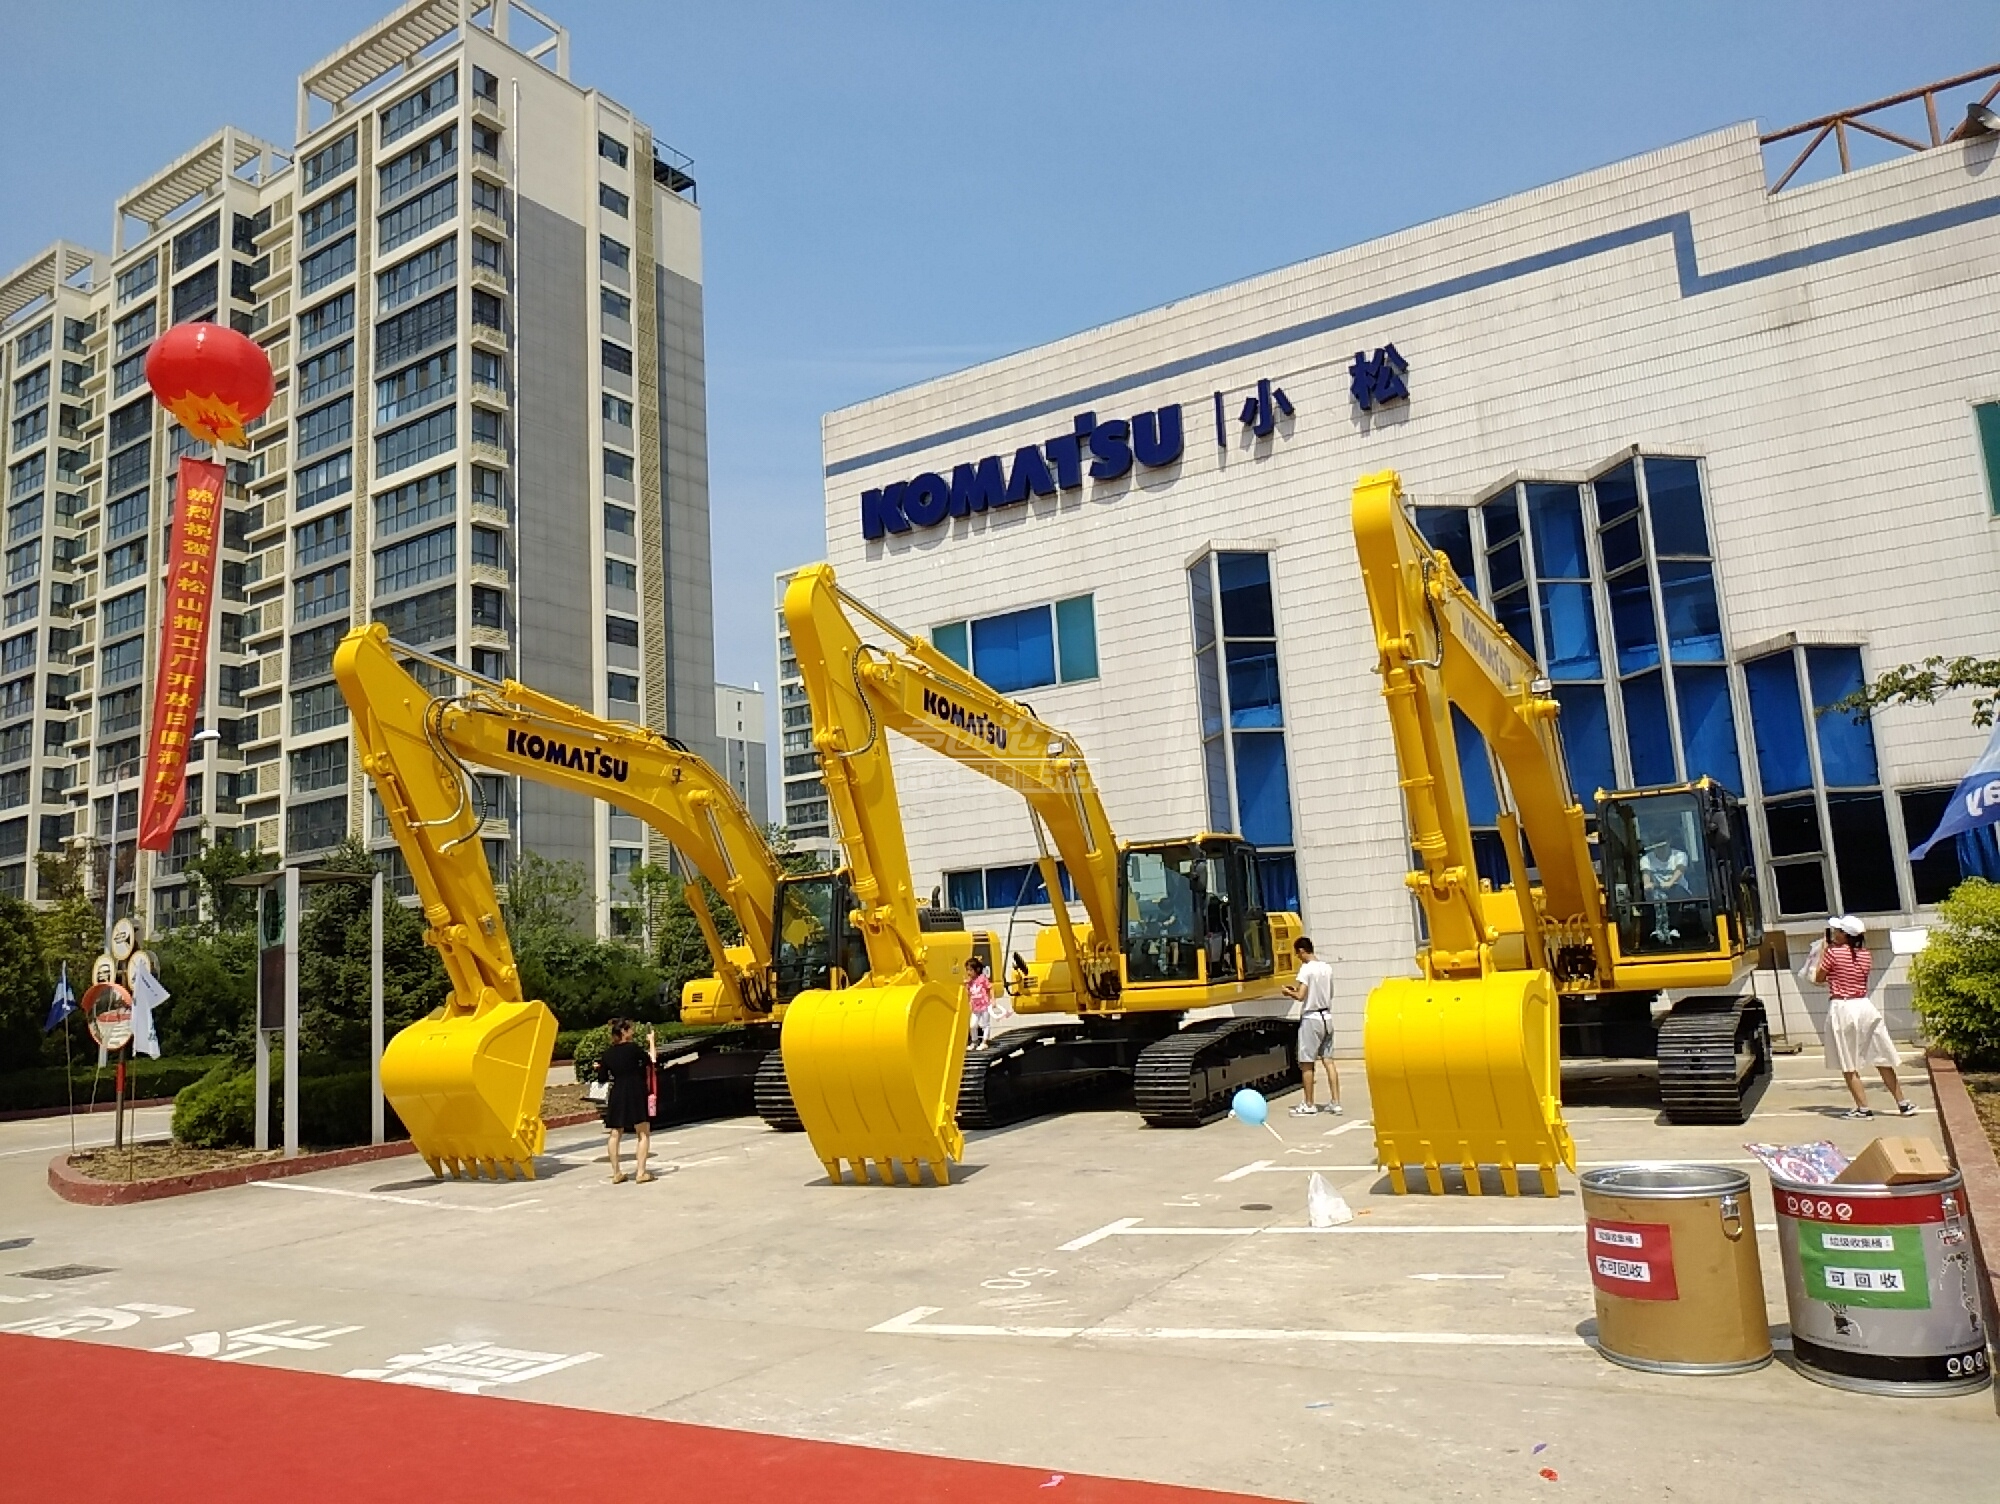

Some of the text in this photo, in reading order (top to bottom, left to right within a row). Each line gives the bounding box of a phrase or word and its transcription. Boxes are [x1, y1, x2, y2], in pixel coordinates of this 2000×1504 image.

[861, 403, 1184, 540] KOMATSU
[1462, 612, 1511, 687] KOMATSU
[924, 688, 1007, 750] KOMATSU
[506, 728, 629, 782] KOMATSU
[1598, 1258, 1645, 1278] 不可回收
[1829, 1271, 1899, 1289] 可回收
